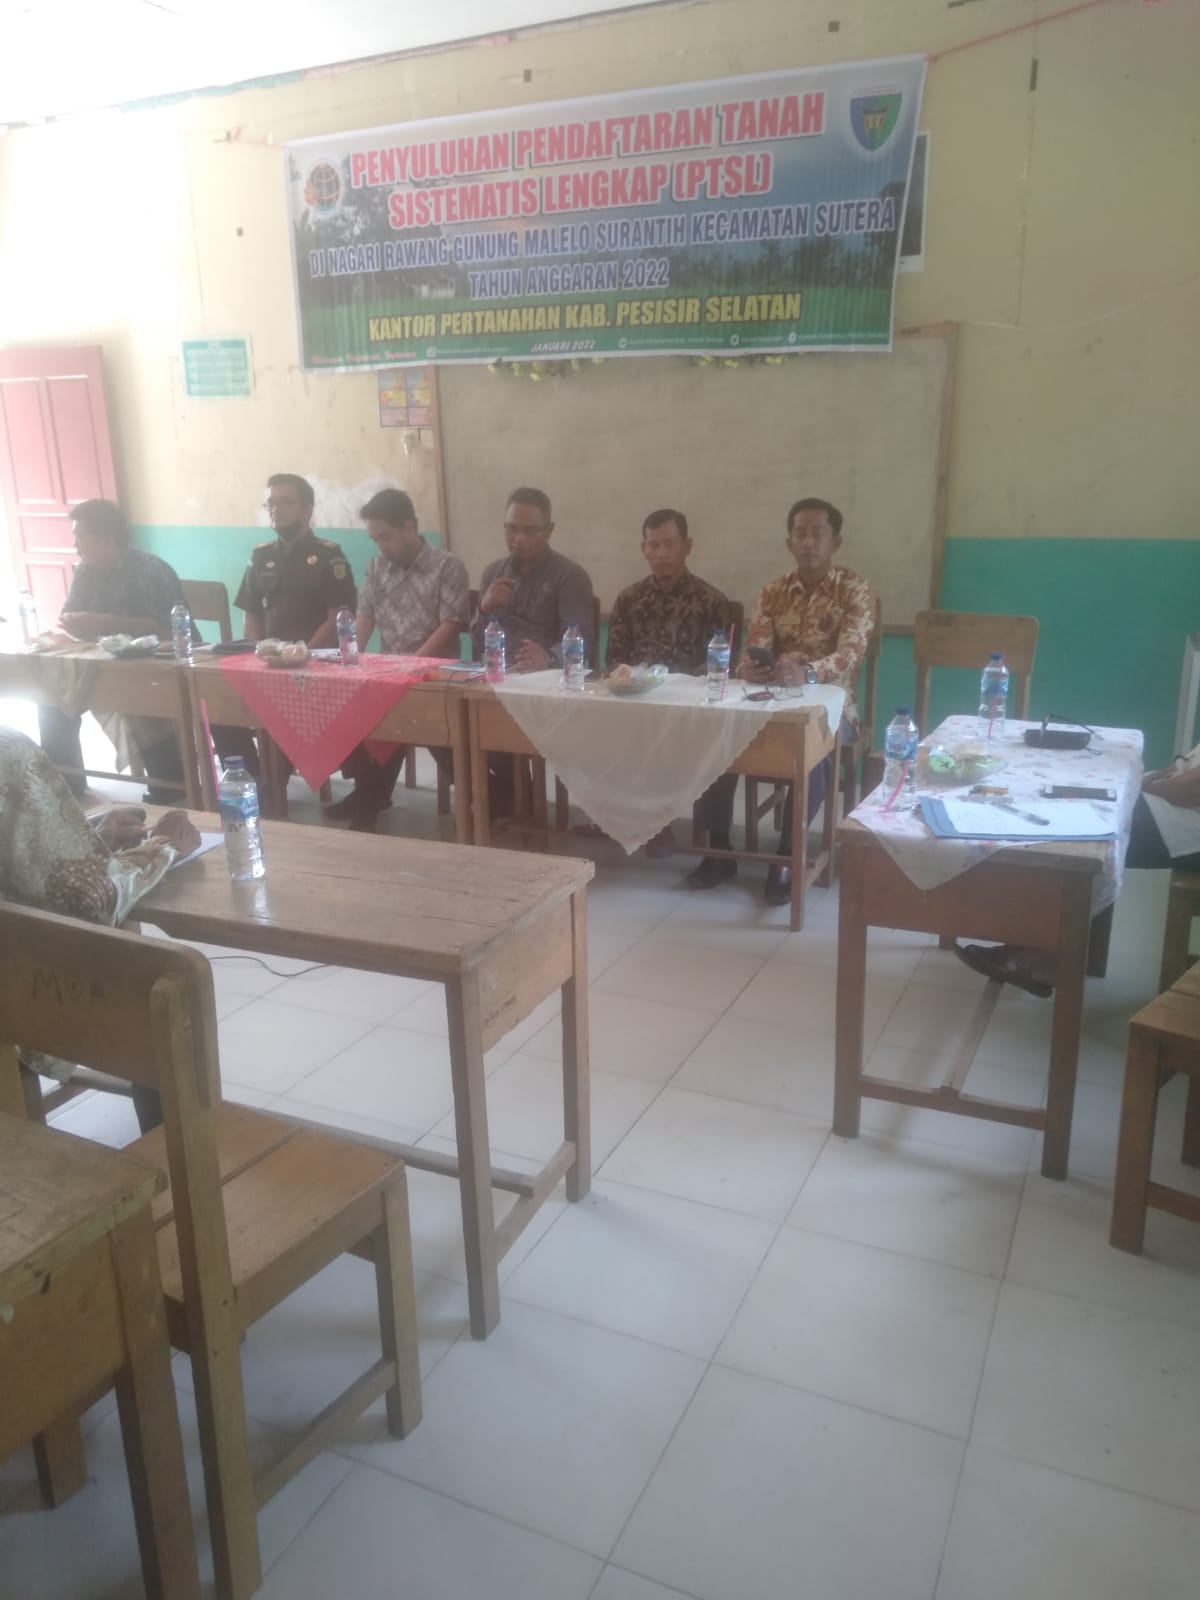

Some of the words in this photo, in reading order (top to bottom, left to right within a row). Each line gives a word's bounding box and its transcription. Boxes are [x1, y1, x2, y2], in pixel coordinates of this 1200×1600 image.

[351, 132, 510, 188] PENYULUHAN
[516, 106, 714, 168] PENDAFTARAN
[721, 91, 825, 142] TANAH
[389, 177, 538, 230] SISTEMATIS
[544, 163, 667, 212] LENGKAP
[673, 152, 772, 201] (PTSL)
[309, 249, 326, 277] DI
[328, 243, 380, 276] NAGARI
[384, 237, 448, 270] RAWANG
[453, 231, 519, 264] GUNUNG
[524, 224, 590, 257] MALELO
[596, 215, 686, 251] SURANTIH
[691, 205, 809, 245] KECAMATAN
[815, 197, 895, 236] SUTERA
[368, 315, 436, 342] KANTOR
[440, 306, 560, 337] PERTANAHAN
[565, 303, 611, 330] KAB.
[616, 297, 701, 326] PESISIR
[705, 293, 802, 323] SELATAN
[469, 271, 522, 299] TAHUN
[527, 262, 617, 294] ANGGARAN
[622, 258, 670, 288] 2022
